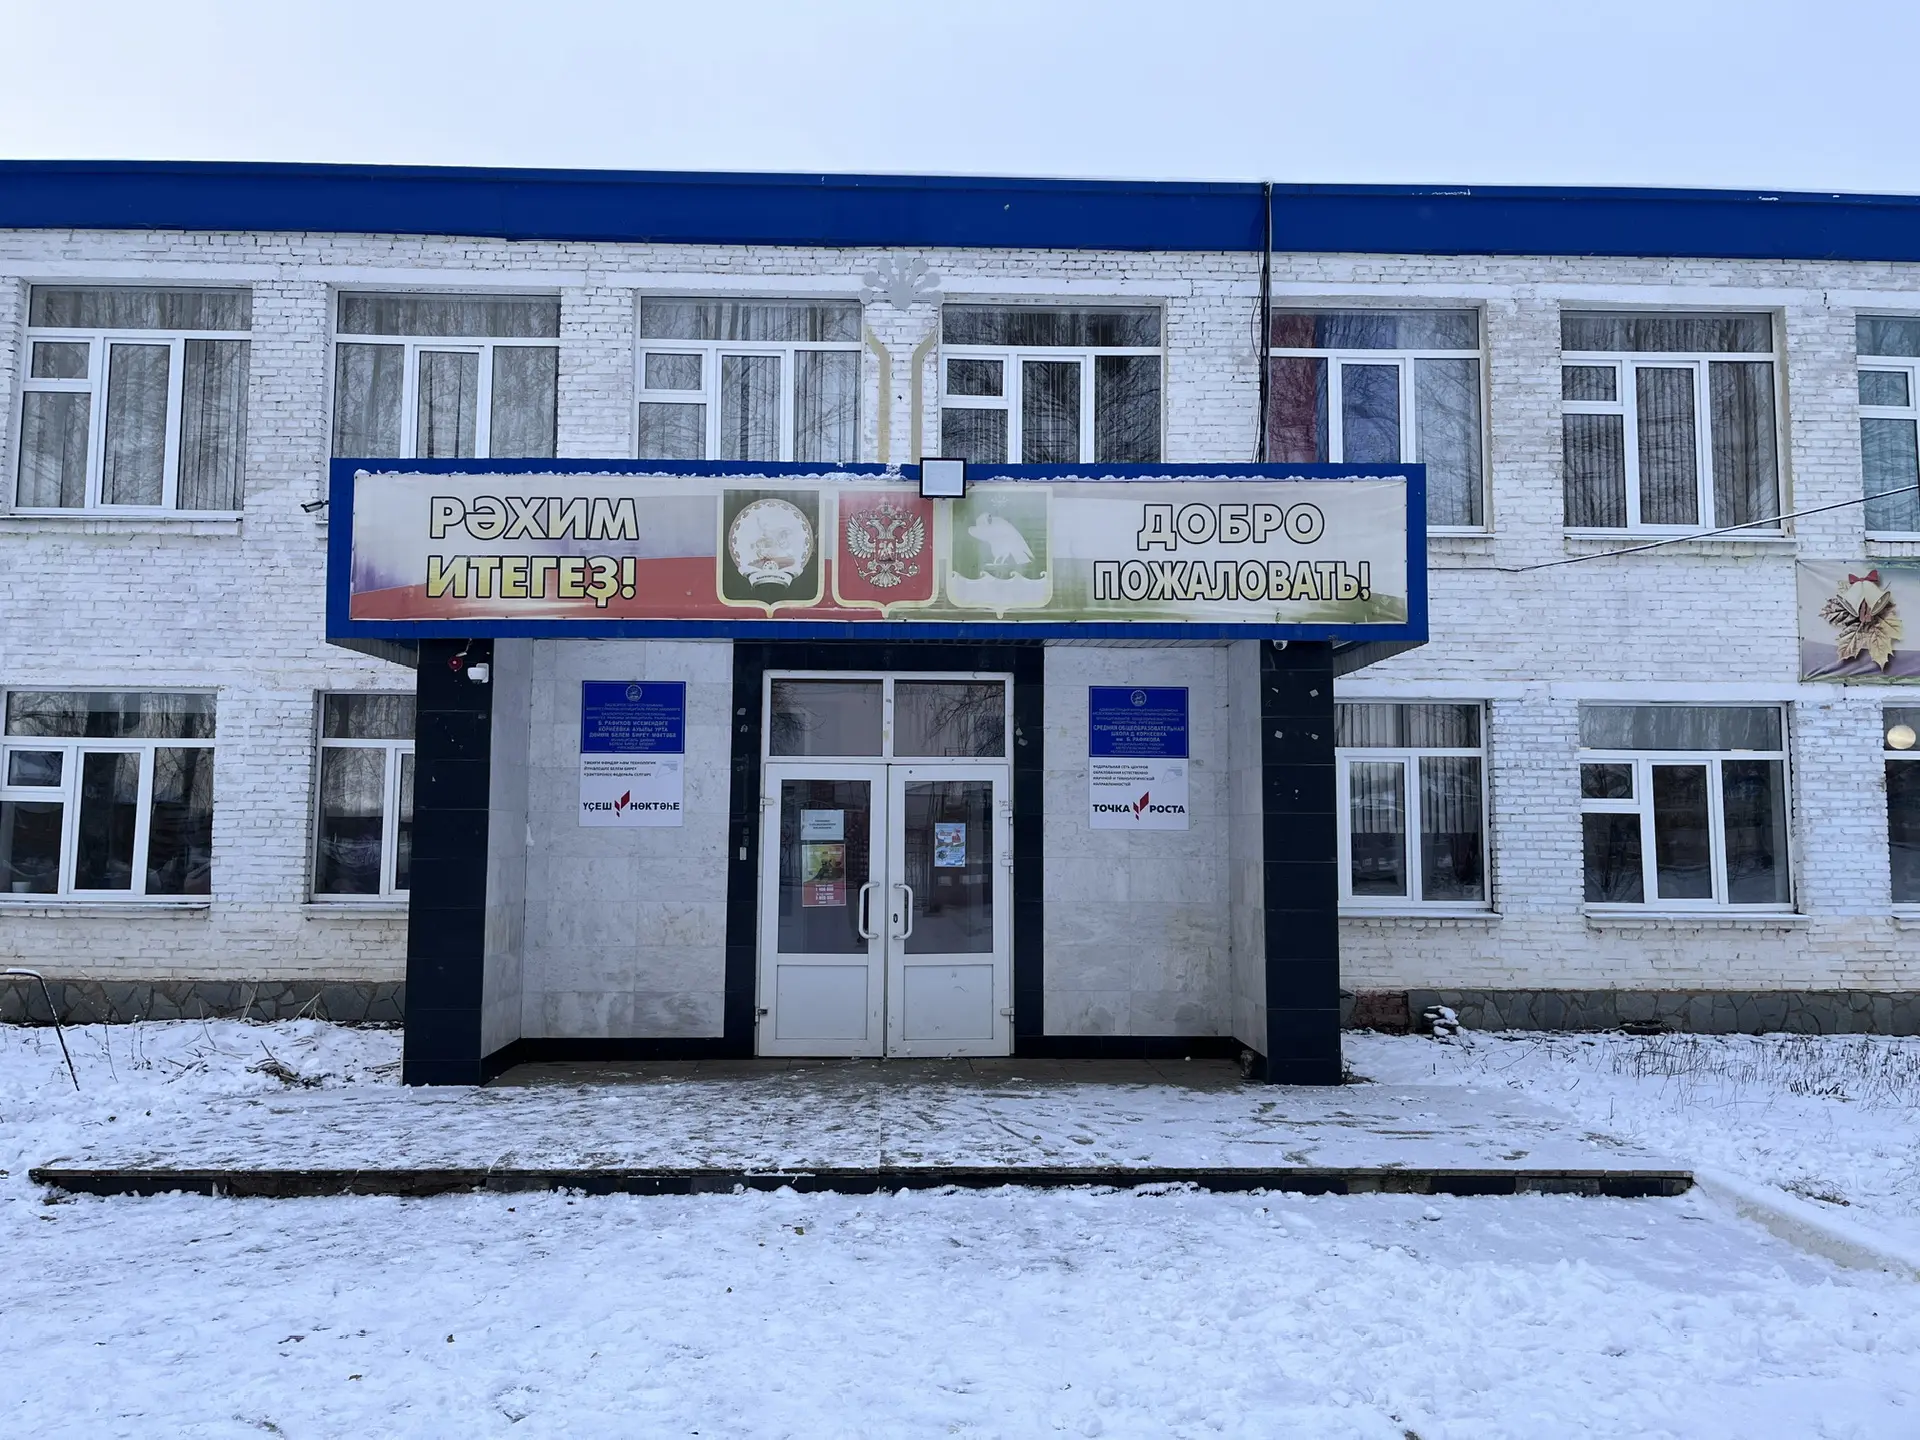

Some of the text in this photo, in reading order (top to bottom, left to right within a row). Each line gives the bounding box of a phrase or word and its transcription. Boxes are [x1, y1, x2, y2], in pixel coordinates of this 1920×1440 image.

[429, 495, 639, 541] РӘХИМ
[1137, 502, 1325, 551] ДОБРО
[426, 555, 637, 608] ИТЕГЕҘ!
[1094, 560, 1371, 601] ПОЖАЛОВАТЬ!
[1092, 804, 1186, 814] ТОЧКА РОСТА
